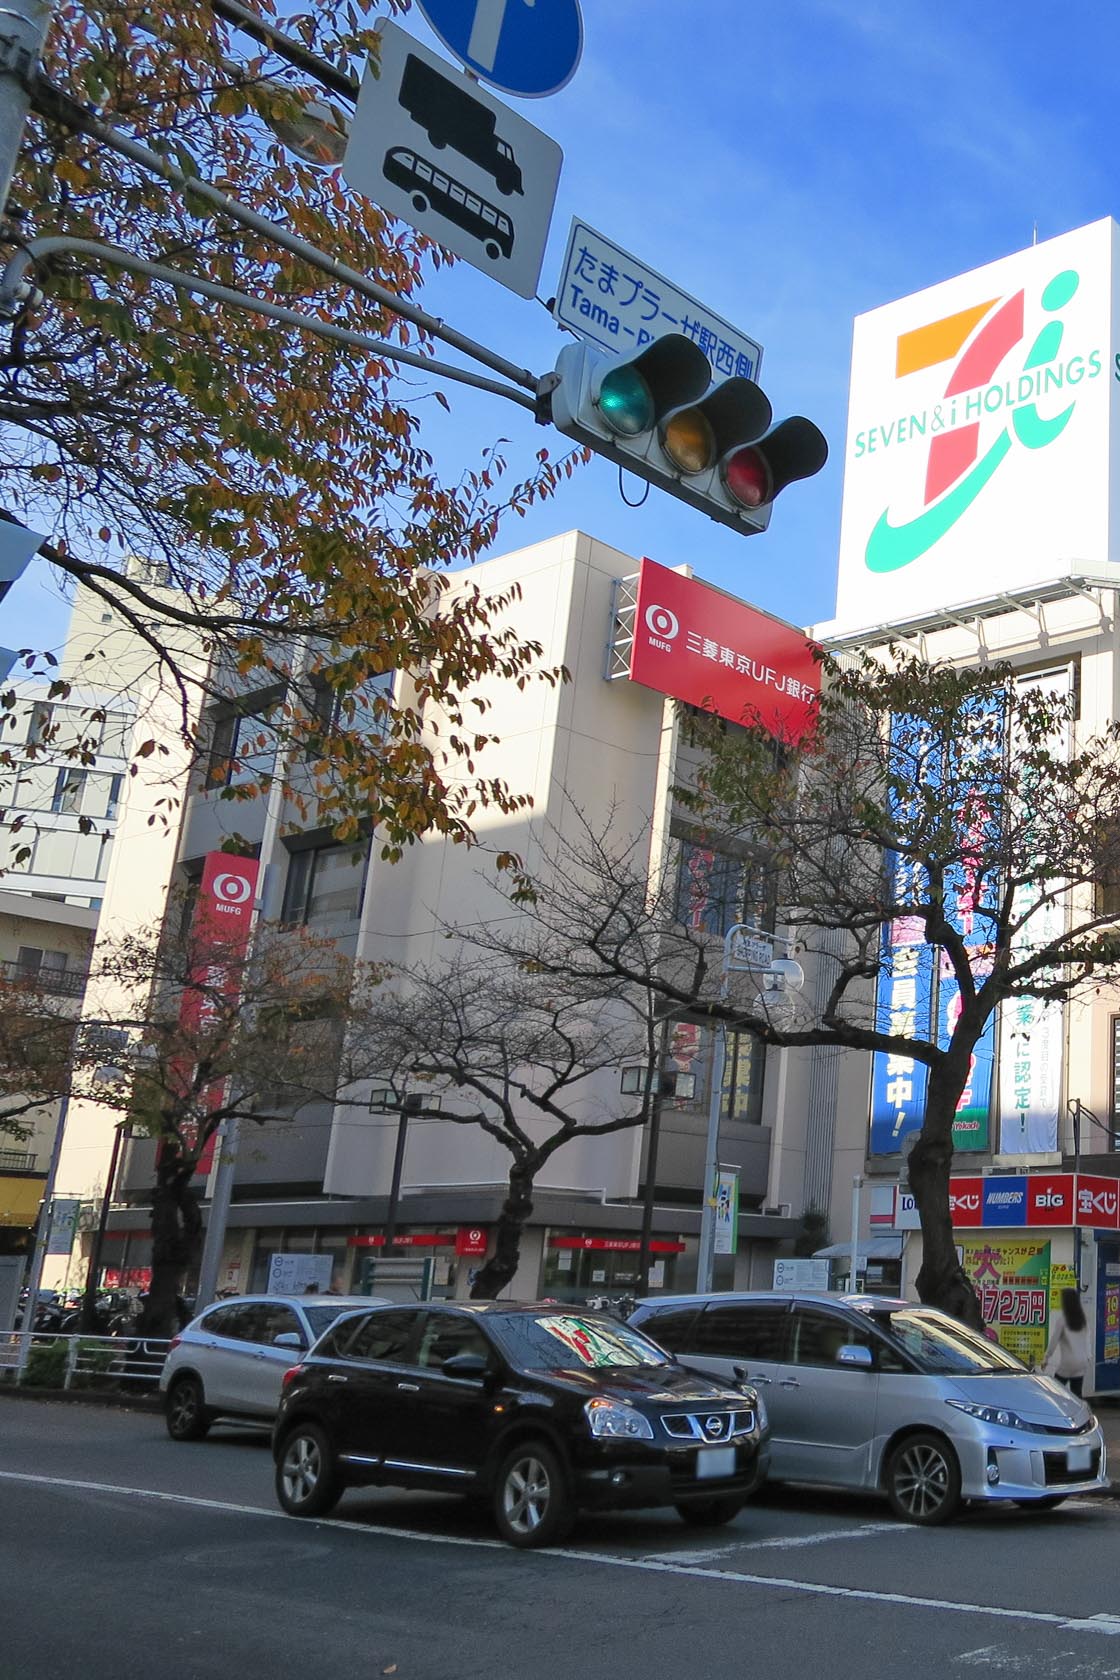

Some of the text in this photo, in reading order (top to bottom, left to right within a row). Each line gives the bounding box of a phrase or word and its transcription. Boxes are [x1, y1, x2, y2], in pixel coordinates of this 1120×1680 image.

[570, 284, 655, 347] Tama-P
[573, 246, 753, 381] たまプラーザ駅西側
[965, 350, 1102, 420] HOLDINGS
[649, 637, 672, 653] MUFG
[686, 630, 816, 705] 三菱東京UFJ銀行
[216, 903, 241, 915] MUFG
[986, 1191, 1023, 1204] NUMBERS
[1035, 1187, 1064, 1207] BIG
[1079, 1189, 1117, 1215] 宝くじ
